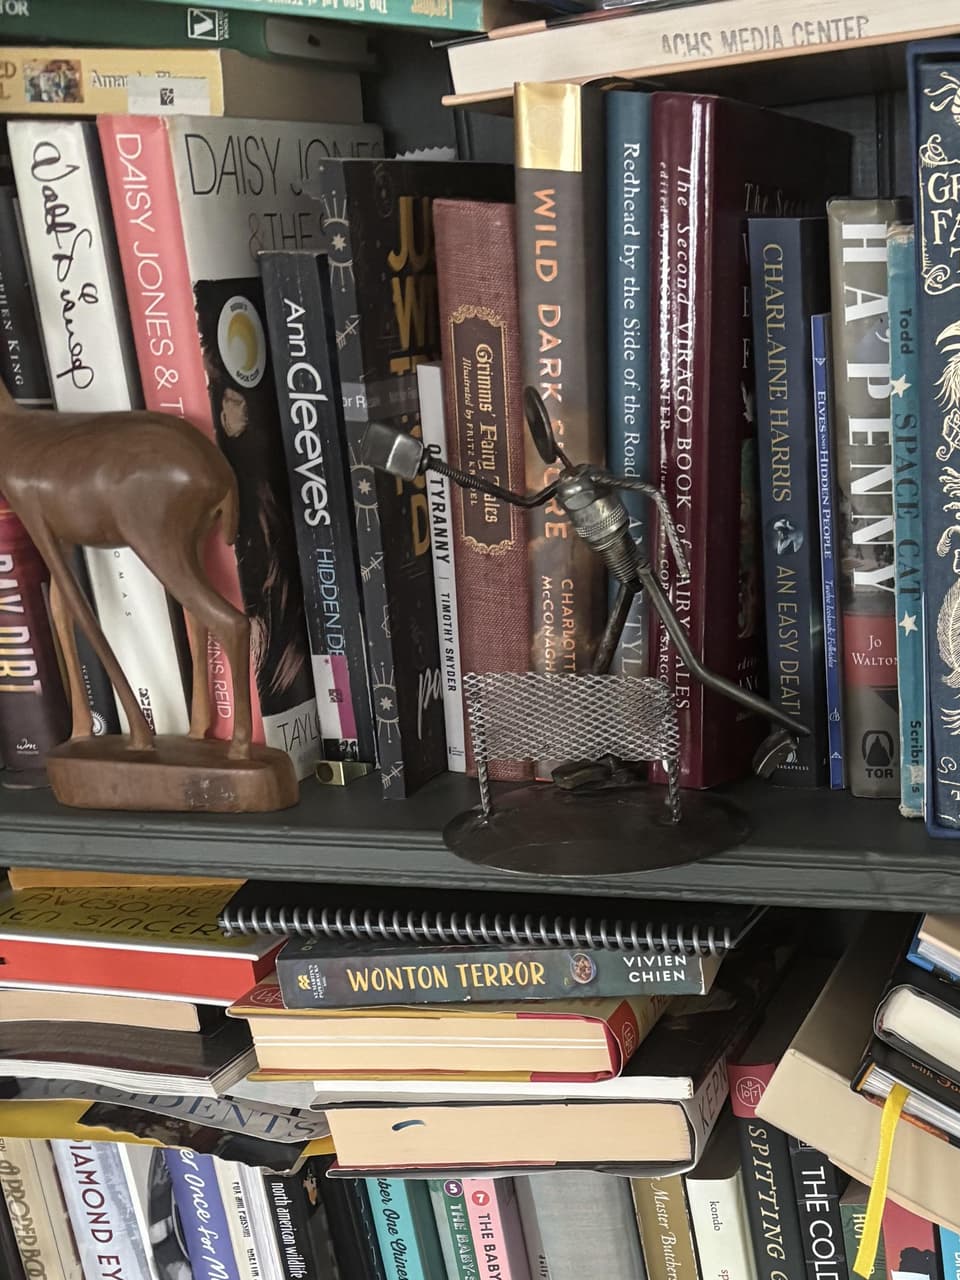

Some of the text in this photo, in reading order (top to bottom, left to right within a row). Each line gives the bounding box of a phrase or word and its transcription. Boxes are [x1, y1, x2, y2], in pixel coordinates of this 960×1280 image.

[721, 25, 784, 53] MEDIA
[115, 134, 180, 391] DAISY JONES &
[620, 143, 640, 478] Redhead by the Side of the Road
[762, 243, 795, 503] CHARLAINE HARRIS
[348, 962, 545, 992] WONTON TERROR
[622, 954, 688, 969] VIVIEN
[628, 968, 686, 984] CHIEN
[802, 1166, 829, 1212] THE
[272, 1183, 307, 1279] north american wildlife
[710, 1201, 723, 1231] kondo
